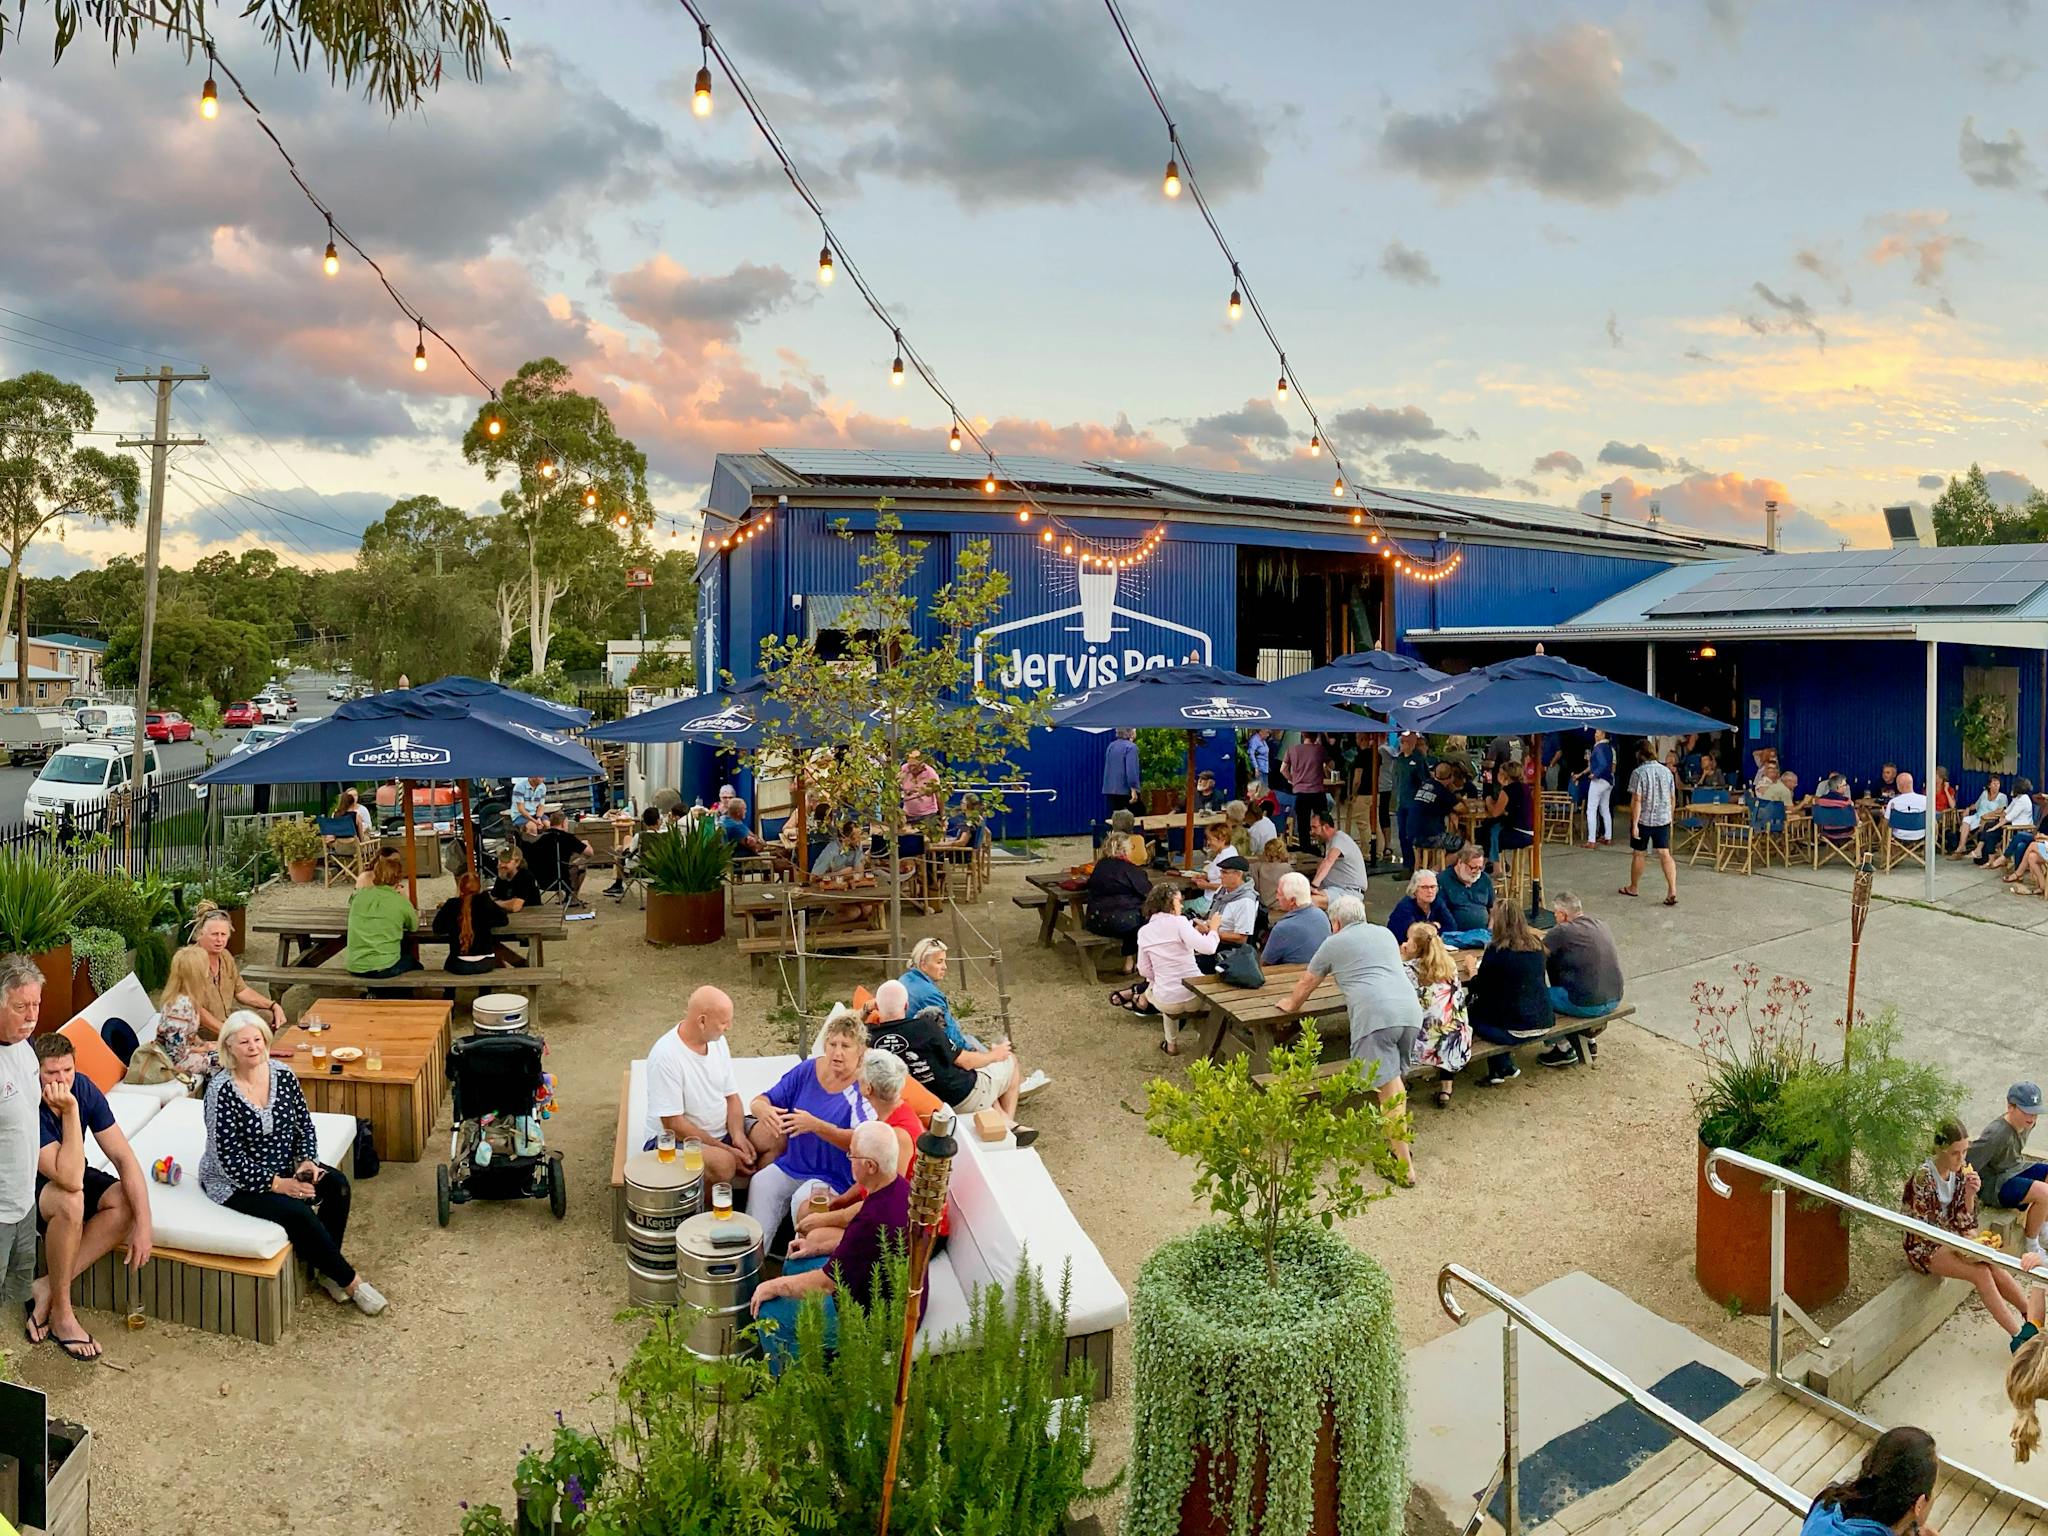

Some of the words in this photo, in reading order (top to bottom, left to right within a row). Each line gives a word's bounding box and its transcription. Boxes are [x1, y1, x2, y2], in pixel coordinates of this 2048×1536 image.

[1000, 645, 1118, 689] Jervis
[1123, 650, 1189, 676] Ba
[358, 750, 409, 762] Jervis
[410, 750, 440, 761] Bay
